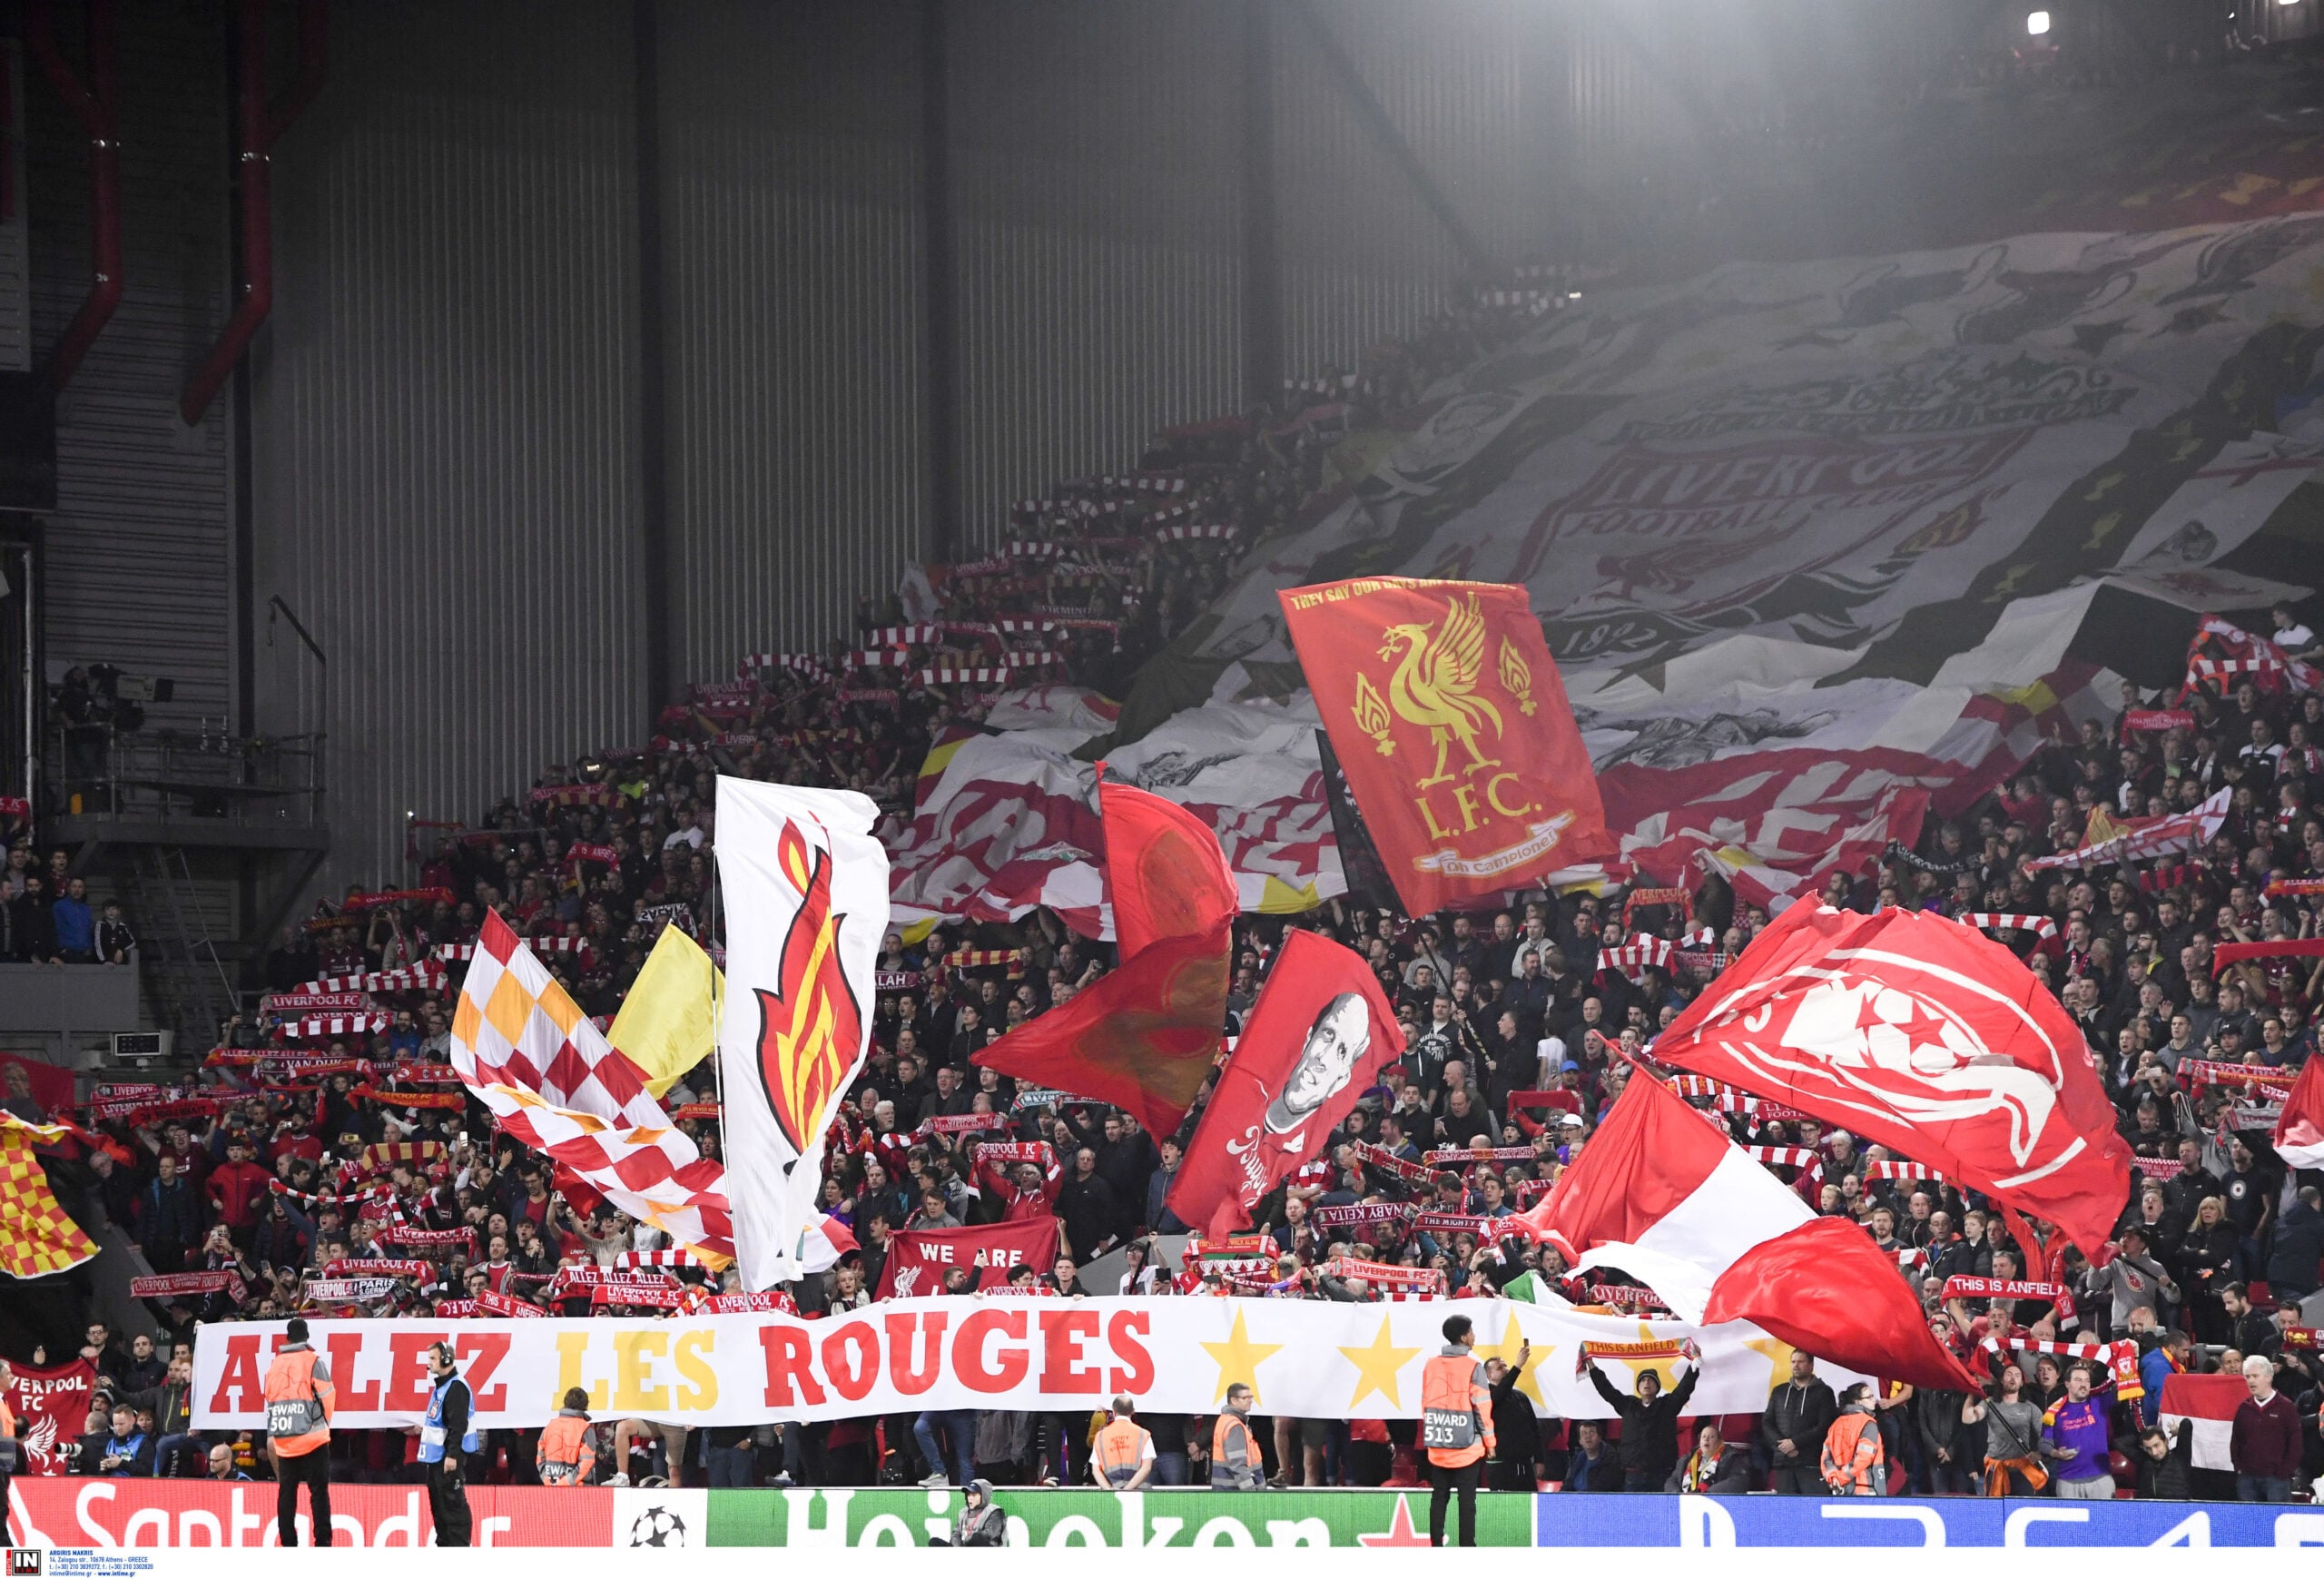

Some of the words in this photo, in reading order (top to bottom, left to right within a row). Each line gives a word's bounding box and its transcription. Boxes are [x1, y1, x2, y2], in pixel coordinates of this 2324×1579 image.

[1291, 593, 1323, 611] THEY
[1326, 585, 1350, 602] SAY
[1353, 581, 1382, 597] OUR
[1562, 623, 1657, 656] 1892
[878, 974, 906, 986] LAH
[274, 995, 342, 1007] LIVERPOOL
[345, 995, 358, 1005] FC
[287, 1060, 313, 1068] VAN
[1025, 1143, 1036, 1154] FC
[1328, 1206, 1365, 1219] KEITA
[1369, 1204, 1403, 1219] NABY
[1424, 1218, 1442, 1226] THE
[1443, 1219, 1476, 1227] MIGHTY
[919, 1242, 954, 1263] WE
[342, 1259, 405, 1269] LIVERPOOL
[570, 1271, 598, 1283] ALLEZ
[603, 1272, 632, 1284] ALLEZ
[636, 1274, 665, 1284] ALLEZ
[1354, 1264, 1409, 1279] LIVERPOOL
[1413, 1269, 1427, 1279] FC
[134, 1279, 172, 1293] LIVERPOOL
[310, 1280, 346, 1297] LIVERPOOL
[359, 1278, 396, 1288] PARIS
[1953, 1279, 1985, 1292] THIS
[1989, 1280, 2004, 1293] IS
[607, 1286, 663, 1300] LIVERPOOL
[667, 1291, 681, 1301] FC
[1594, 1288, 1664, 1305] LIVERPOO
[484, 1294, 499, 1306] THIS
[503, 1299, 511, 1309] IS
[627, 1297, 643, 1305] NEVER
[716, 1294, 772, 1308] LIVEROOL
[779, 1295, 791, 1308] FC
[1590, 1342, 1614, 1352] THIS
[1616, 1342, 1625, 1352] IS
[1627, 1340, 1675, 1352] ANFIELD
[210, 1332, 512, 1413] ALEZ
[551, 1329, 718, 1412] LES
[759, 1309, 1155, 1408] ROUGES
[10, 1376, 88, 1395] VERPOOL
[21, 1395, 44, 1411] FC
[271, 1416, 292, 1431] 508
[1424, 1412, 1468, 1426] EWARD
[1424, 1426, 1453, 1443] 513
